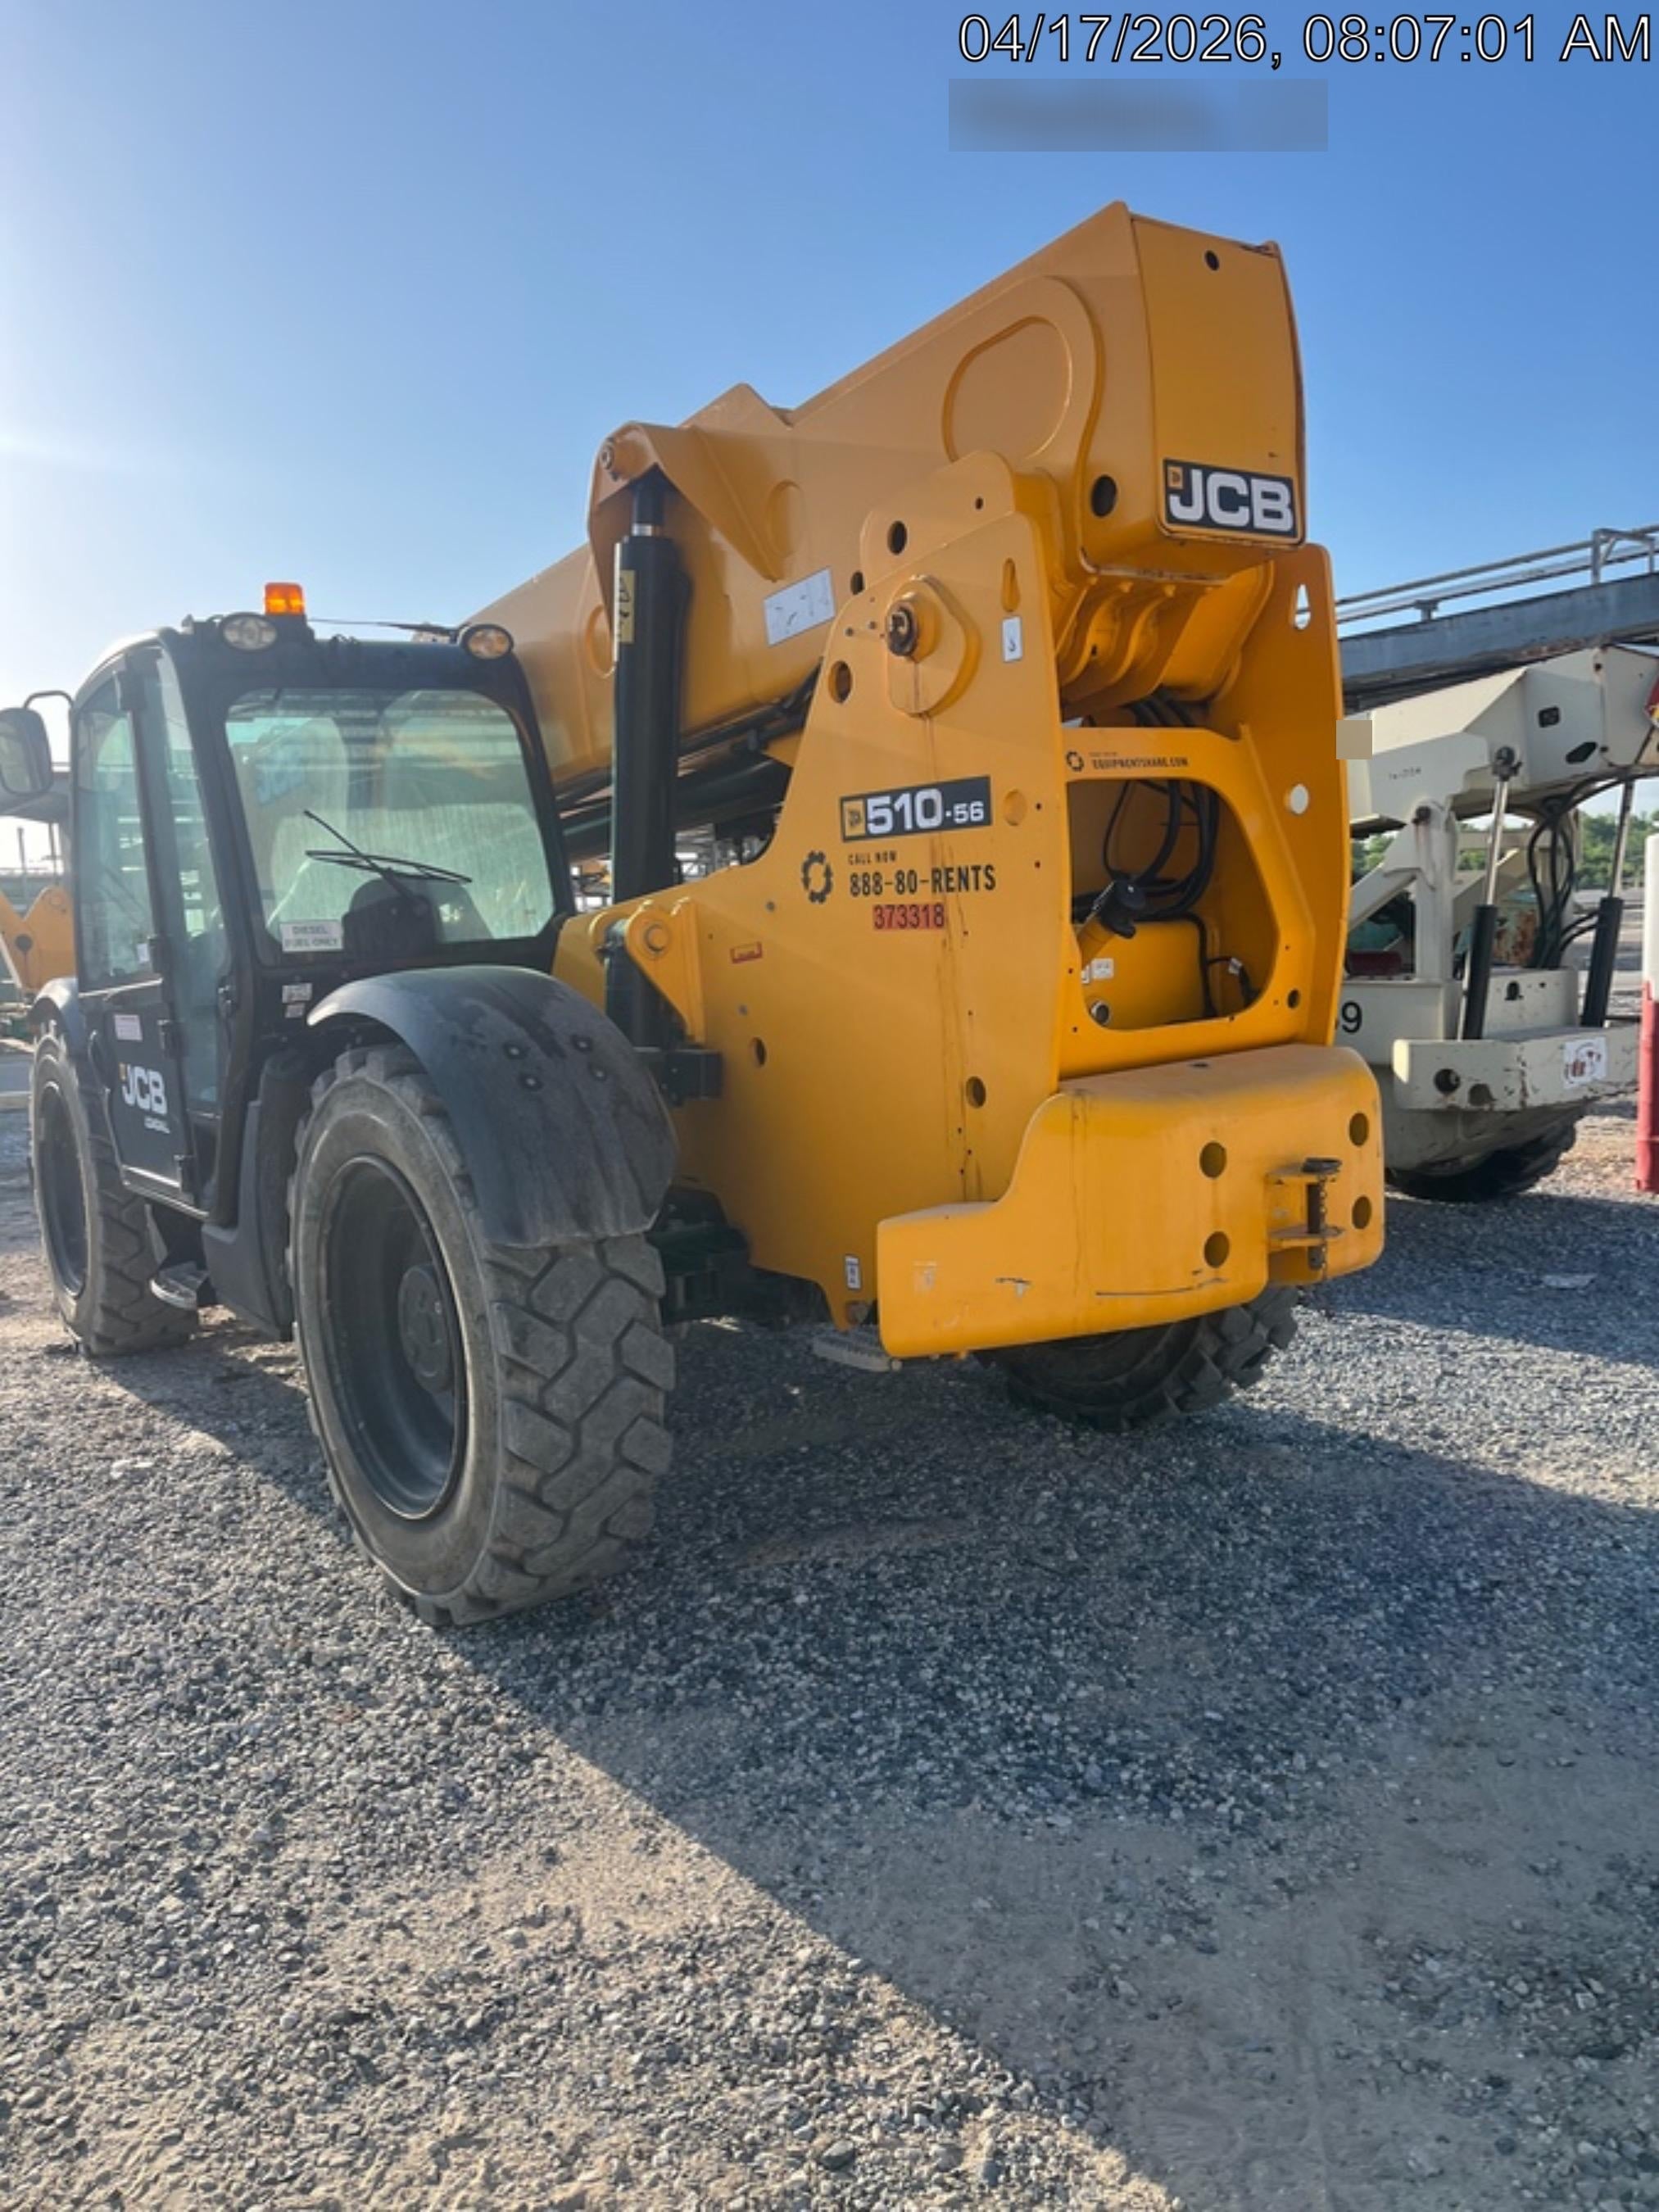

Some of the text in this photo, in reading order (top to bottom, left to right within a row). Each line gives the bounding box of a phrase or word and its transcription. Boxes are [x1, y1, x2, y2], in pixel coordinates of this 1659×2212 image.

[1169, 469, 1294, 532] JCB
[865, 788, 985, 836] 510-56
[849, 864, 997, 897] 888-80-RENTS
[873, 902, 945, 931] 373318
[122, 1063, 168, 1114] JCB
